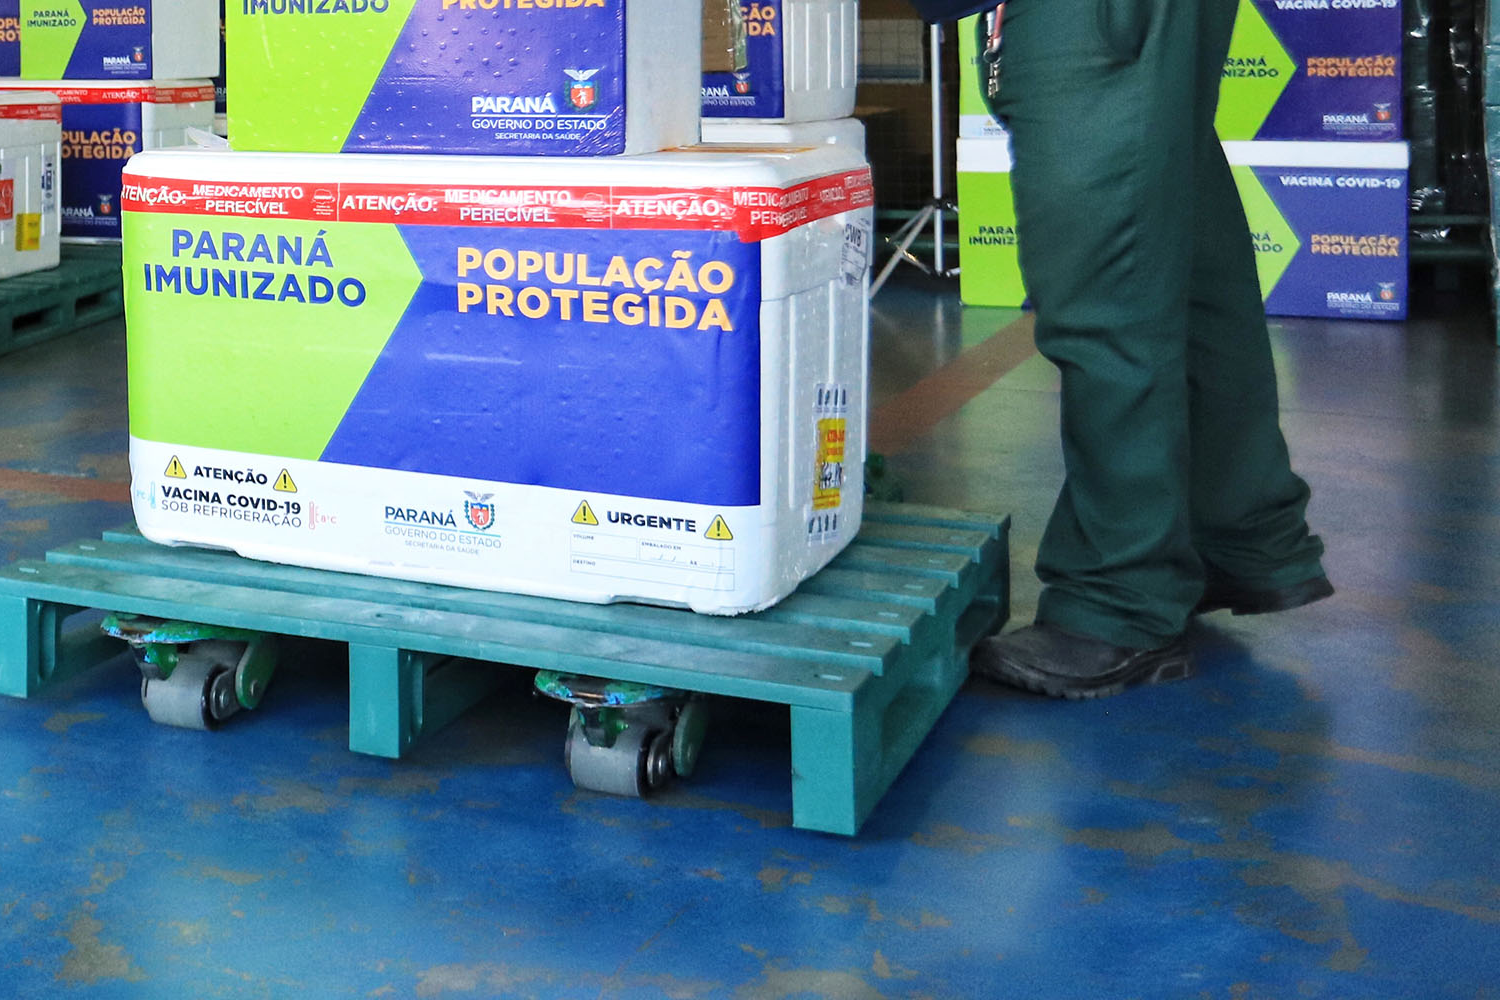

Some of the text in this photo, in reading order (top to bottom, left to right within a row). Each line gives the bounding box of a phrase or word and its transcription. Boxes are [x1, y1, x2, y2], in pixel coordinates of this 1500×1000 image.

[92, 5, 146, 16] POPULAÇÃO
[1275, 0, 1329, 10] VACINA
[33, 9, 69, 18] PARANÁ
[92, 15, 146, 25] PROTEGIDA
[27, 18, 77, 27] IMUNIZADO
[103, 55, 130, 64] PARANÁ
[1307, 55, 1396, 67] POPULAÇÃO
[1307, 66, 1395, 78] PROTEGIDA
[471, 92, 556, 113] PARANÁ
[471, 118, 607, 130] GOVERNO DO ESTADO
[1322, 113, 1369, 123] PARANÁ
[61, 128, 136, 144] PULAÇÃO
[494, 131, 581, 140] SECRETARIA DA SAÚDE
[61, 145, 135, 159] OTEGIDA
[1279, 175, 1401, 188] VACINA COVID-19
[192, 184, 304, 199] MEDICAMENTO
[205, 199, 288, 215] PERECÍVEL
[342, 193, 438, 215] ATENÇÃO:
[444, 188, 571, 206] MEDICAMENTO
[616, 196, 725, 221] ATENÇÃO:
[459, 204, 555, 223] PERECÍVEL
[1311, 234, 1399, 246] POPULAÇÃO
[172, 229, 334, 268] PARANÁ
[1311, 244, 1398, 256] PROTEGIDA
[457, 247, 734, 295] POPULAÇÃO
[144, 263, 367, 308] IMUNIZADO
[1326, 292, 1372, 303] PARANÁ
[457, 282, 733, 332] PROTEGIDA
[193, 465, 268, 486] ATENÇÃO
[161, 486, 301, 515] VACINA COVID-19
[161, 499, 302, 528] SOB REFRIGERAÇÃO
[385, 506, 457, 528] PARANÁ
[607, 510, 697, 533] URGENTE
[385, 526, 502, 549] GOVERNO DO ESTADO
